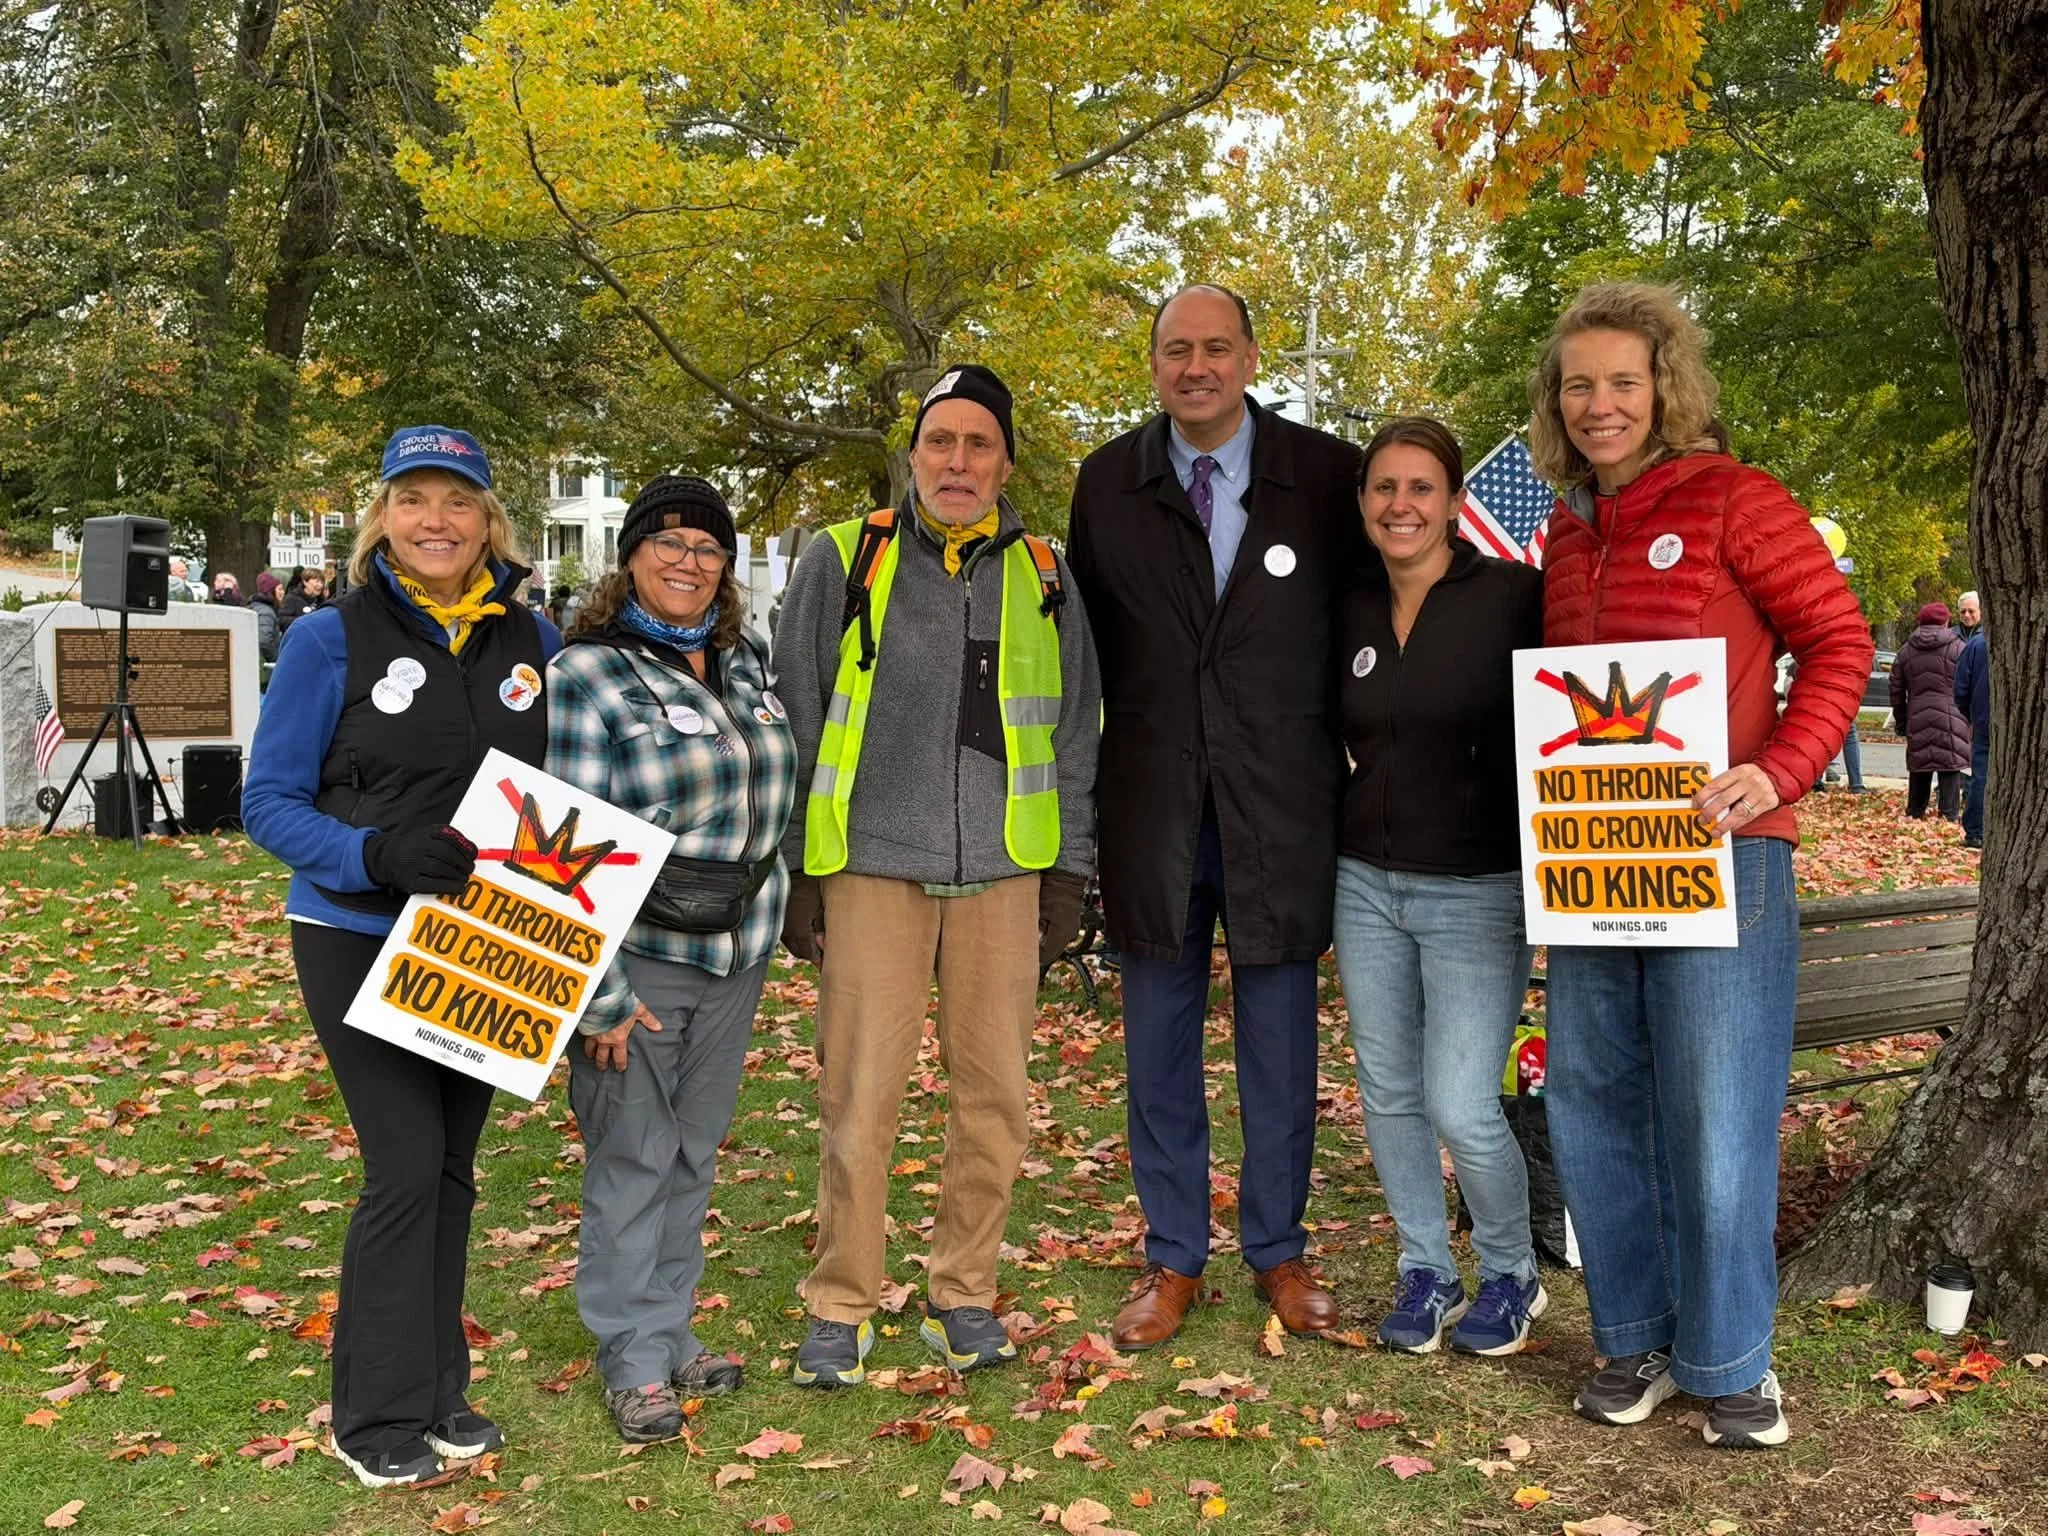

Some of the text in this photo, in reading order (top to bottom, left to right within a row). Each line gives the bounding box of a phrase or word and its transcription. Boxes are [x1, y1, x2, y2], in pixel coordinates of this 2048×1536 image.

[399, 443, 461, 457] DEMOCRACY
[400, 434, 437, 448] CHOOSE
[278, 551, 292, 564] 111
[304, 553, 320, 566] 110
[1539, 766, 1708, 802] NO THRONES
[1542, 814, 1713, 850] NO CROWNS
[1544, 864, 1716, 909] NO KINGS
[481, 888, 602, 965] THRONES
[1592, 920, 1668, 933] NOKINGS.ORG
[414, 912, 579, 1012] NO CROWNS
[384, 958, 554, 1060] NO KINGS
[414, 1027, 486, 1064] NOKINGS.ORG
